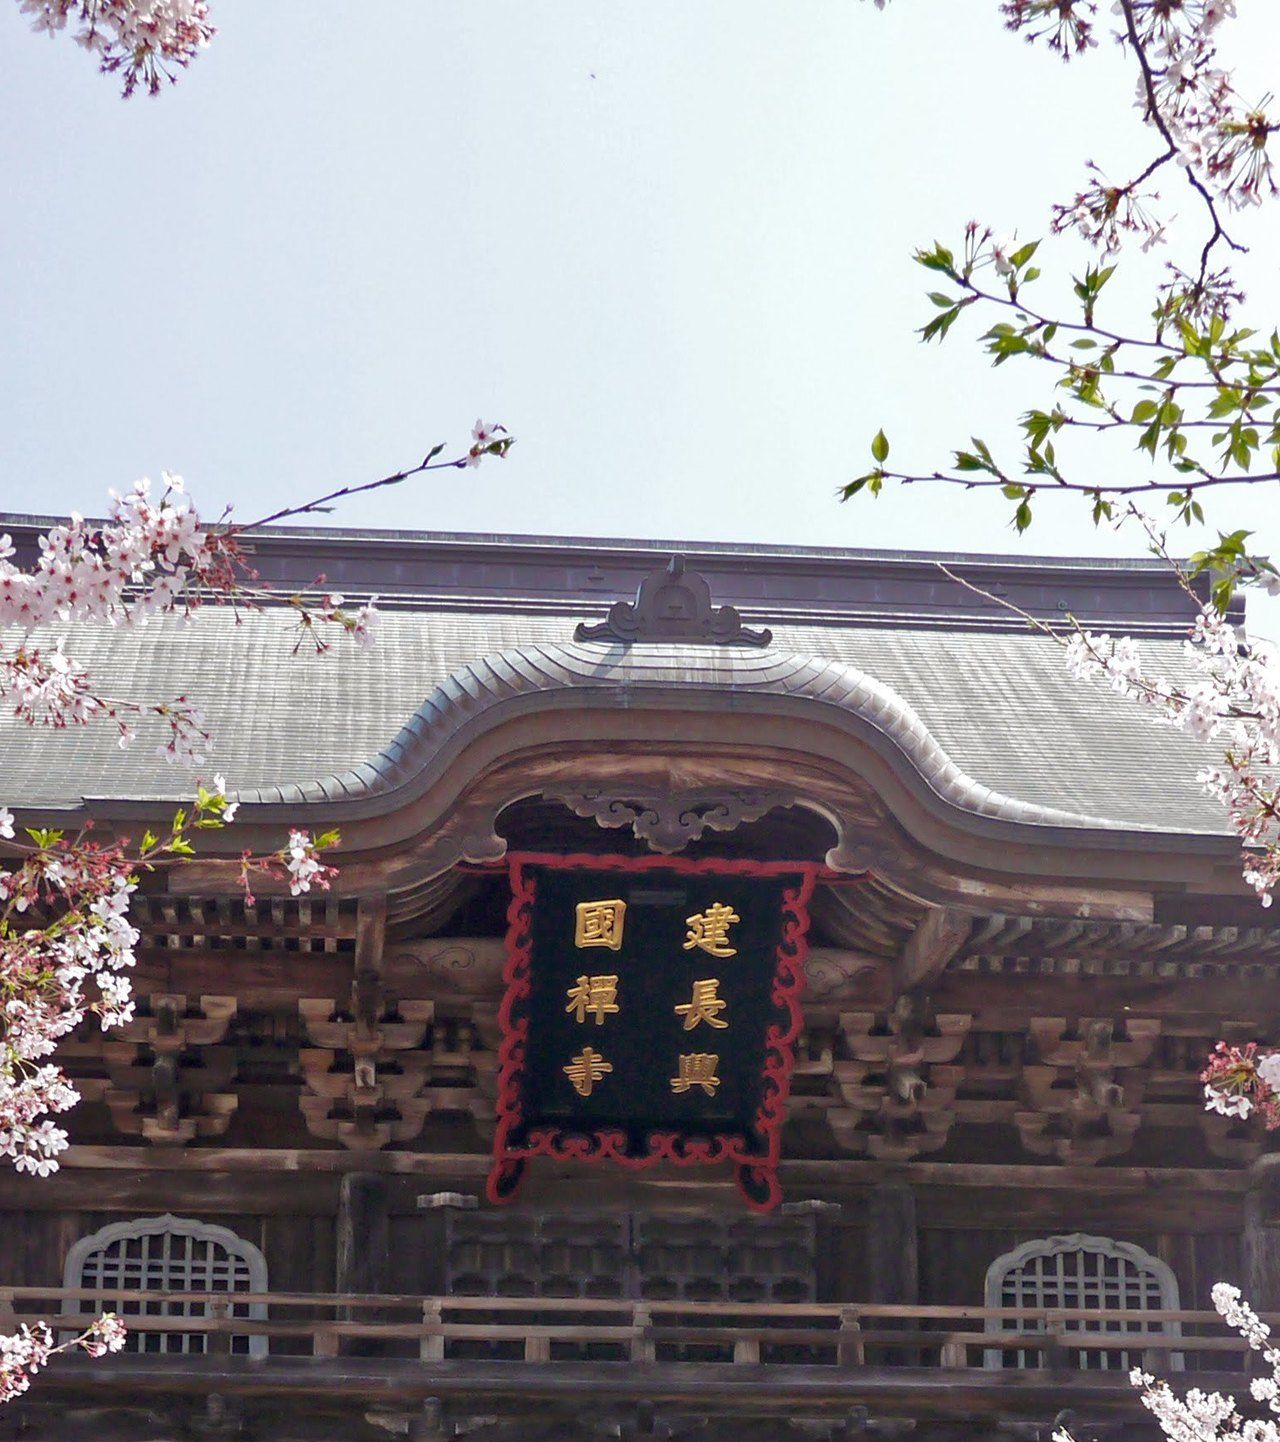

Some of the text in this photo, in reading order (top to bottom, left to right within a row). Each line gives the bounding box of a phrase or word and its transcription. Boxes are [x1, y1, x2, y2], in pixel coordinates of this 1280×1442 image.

[563, 899, 627, 1097] 國禪寺
[670, 902, 740, 1097] 建長興
